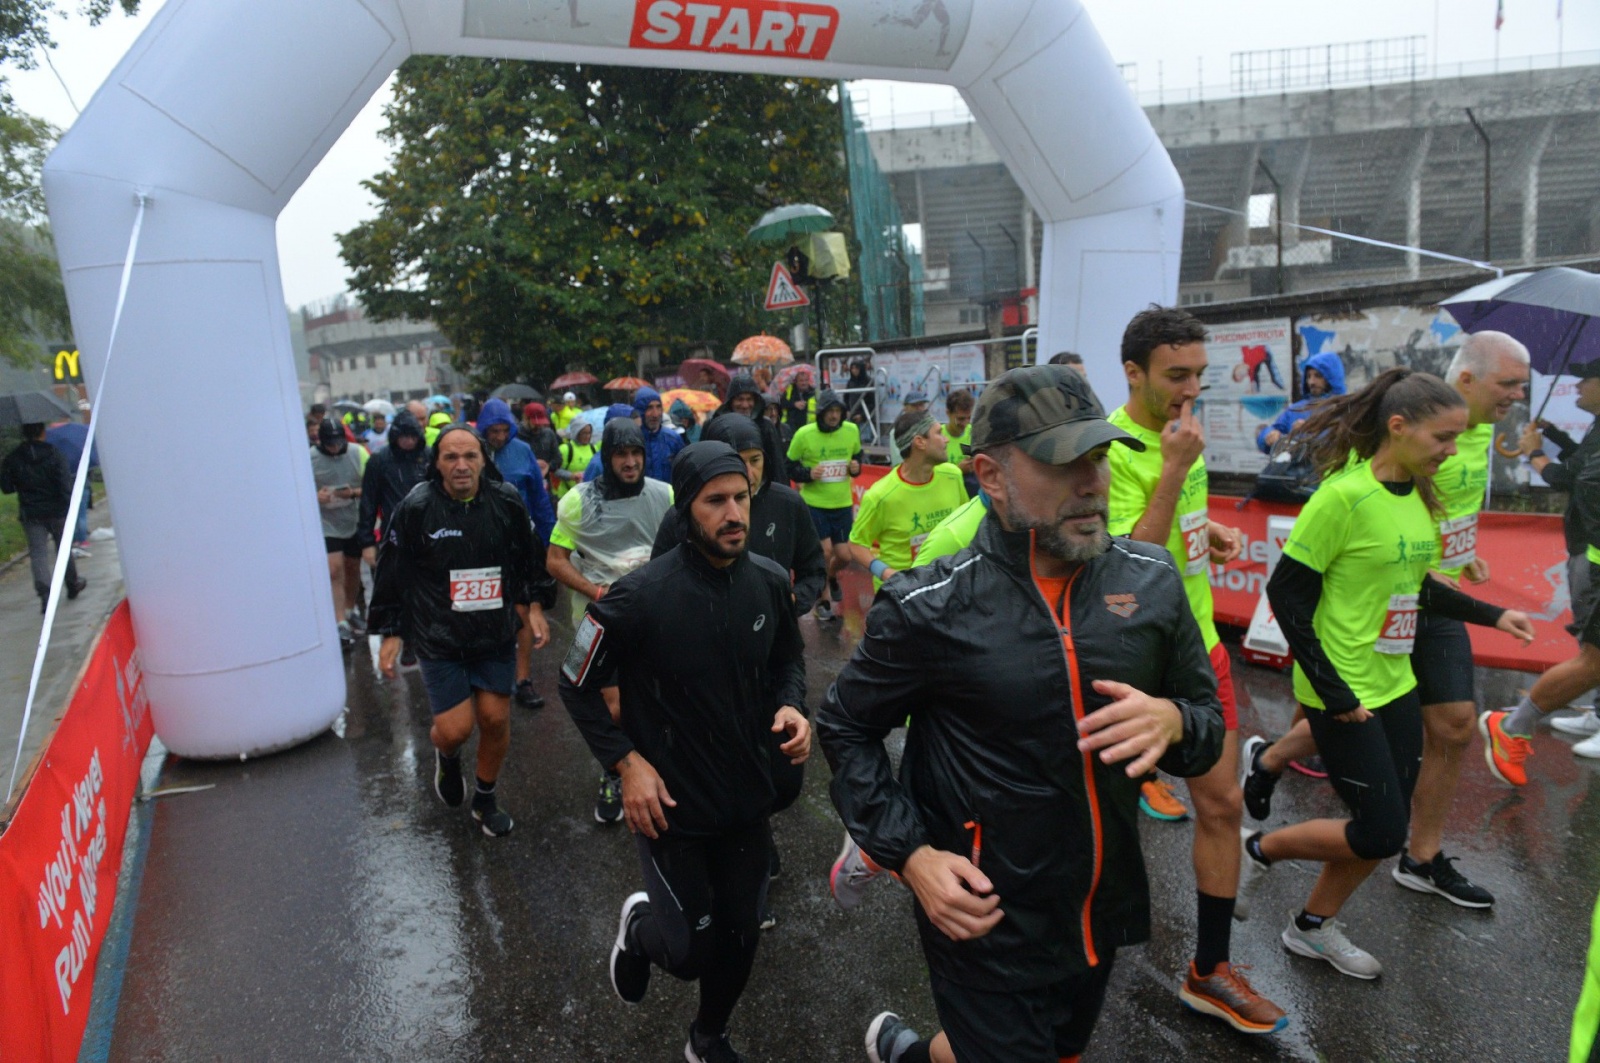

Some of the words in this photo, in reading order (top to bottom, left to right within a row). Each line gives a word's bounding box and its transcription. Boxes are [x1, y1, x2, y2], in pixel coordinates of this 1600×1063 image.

[641, 0, 831, 54] START
[821, 465, 848, 477] 2078
[454, 580, 500, 600] 2367
[1208, 562, 1267, 593] Alon
[72, 746, 104, 843] Never
[55, 909, 91, 1016] Run
